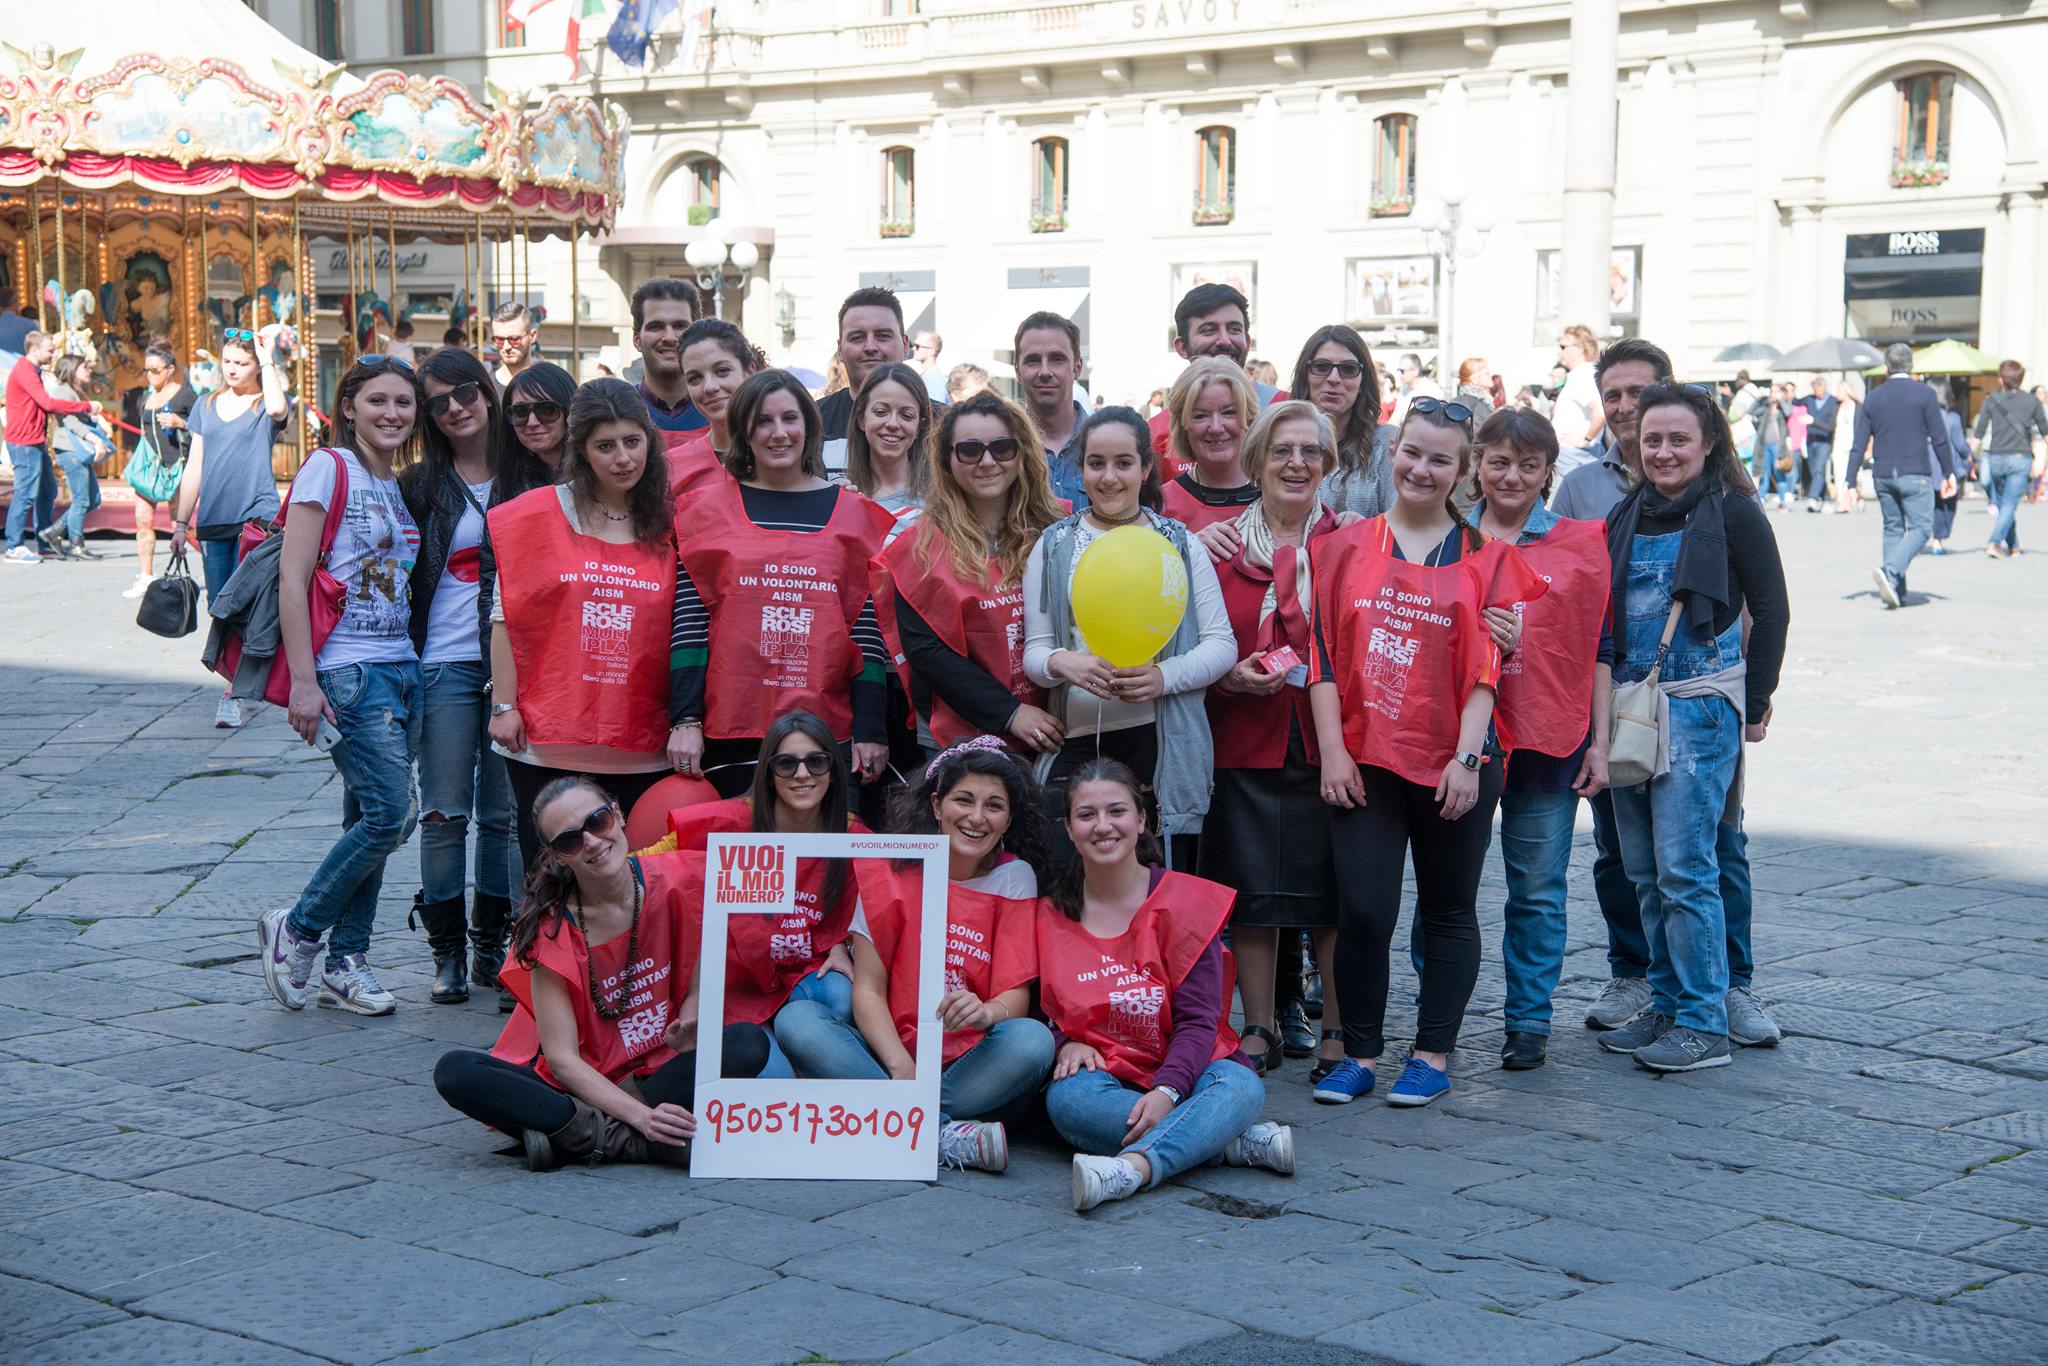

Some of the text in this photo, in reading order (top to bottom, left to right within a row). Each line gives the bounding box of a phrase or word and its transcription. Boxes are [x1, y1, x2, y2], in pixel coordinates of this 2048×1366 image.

[1132, 0, 1240, 28] SAVOY
[1888, 231, 1940, 250] BOSS
[1890, 307, 1938, 321] BOSS
[1178, 463, 1192, 471] UN
[585, 561, 636, 575] IO SONO
[764, 564, 817, 576] IO SONO
[560, 573, 660, 591] UN VOLONTARIO
[739, 576, 838, 593] UN VOLONTARIO
[592, 587, 624, 599] AISM
[772, 591, 802, 602] AISM
[1381, 587, 1432, 607] IO SONO
[582, 601, 633, 617] SCLE
[979, 600, 996, 610] UN
[762, 605, 811, 621] SCLE
[1354, 599, 1452, 628] UN VOLONTARIO
[1383, 615, 1413, 632] AISM
[1370, 627, 1418, 652] SCLE
[582, 674, 600, 683] libero
[616, 677, 627, 685] SM
[605, 670, 628, 678] mondo
[763, 679, 779, 687] libero
[850, 841, 940, 850] #VUOIILMIONUMERO?
[716, 890, 784, 904] NUMERO?
[780, 918, 806, 929] AISM
[949, 923, 984, 943] SONO
[602, 976, 617, 989] IO
[1077, 971, 1098, 982] UN
[1108, 986, 1163, 1001] SCLE
[617, 1000, 668, 1034] SCLE
[622, 1016, 666, 1048] ROS
[705, 1099, 925, 1150] 95051730109
